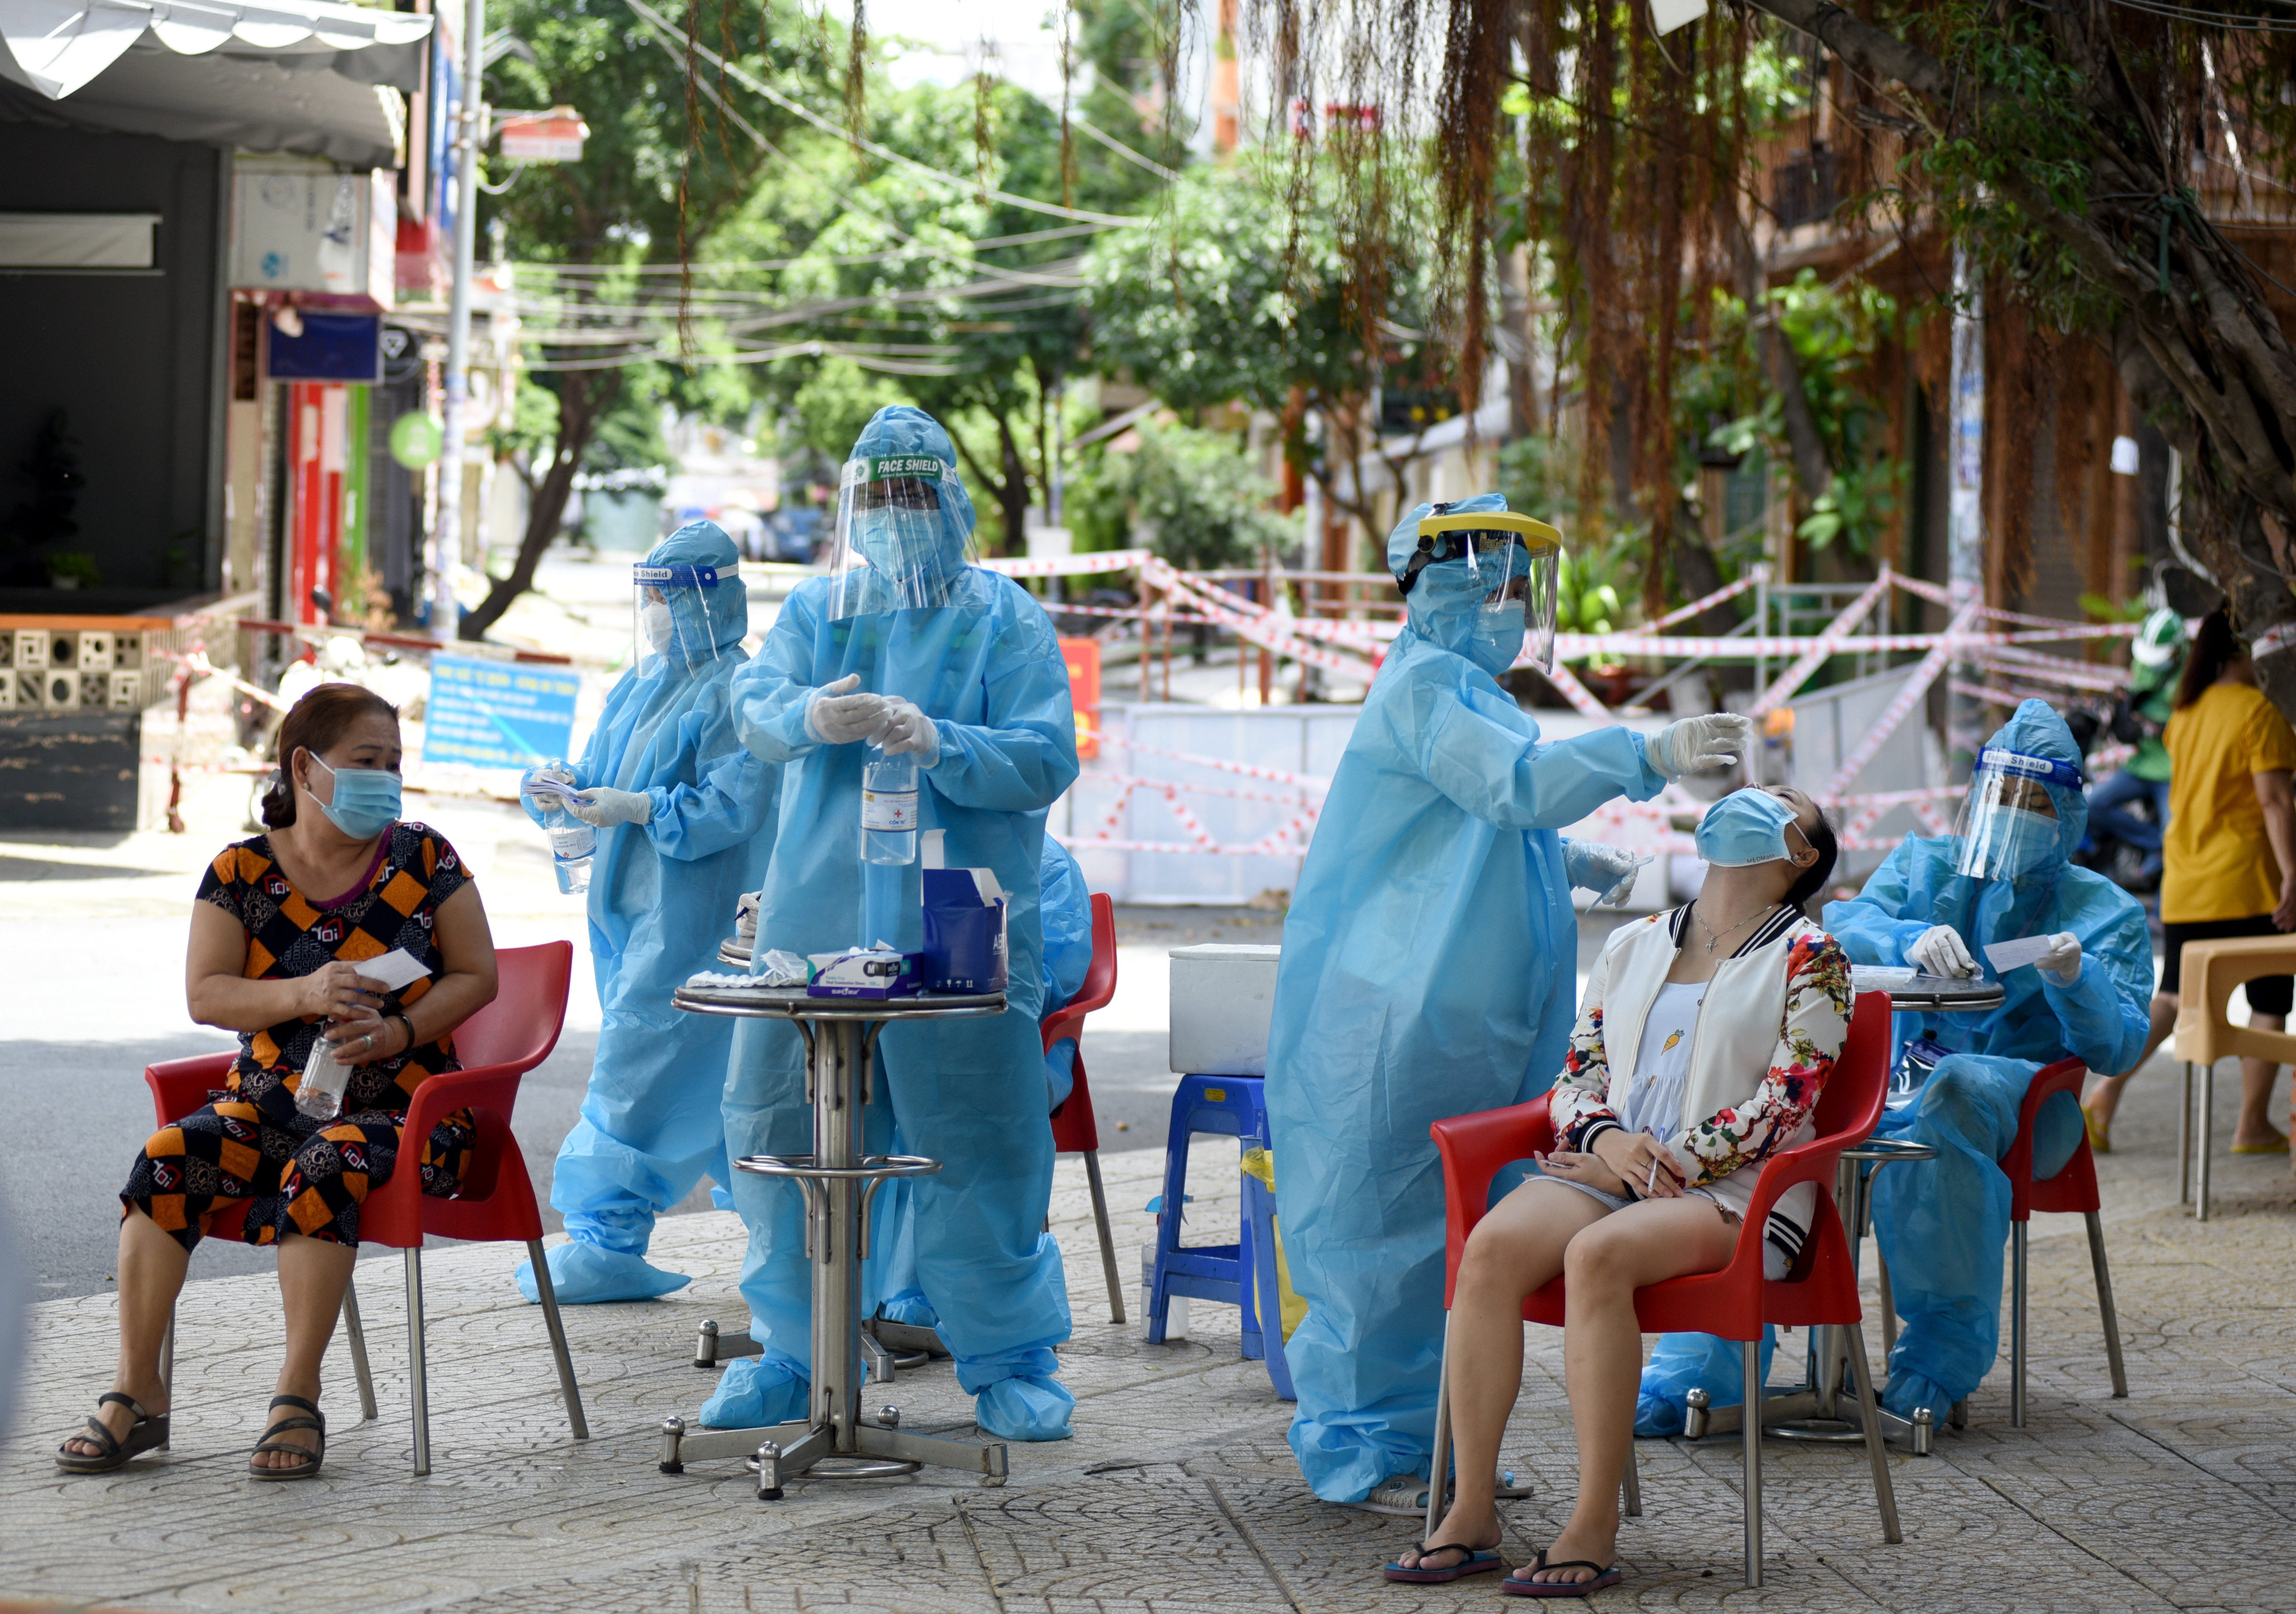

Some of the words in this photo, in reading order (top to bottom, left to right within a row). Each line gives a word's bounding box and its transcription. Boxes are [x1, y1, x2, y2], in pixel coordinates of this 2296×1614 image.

[877, 459, 904, 473] FACE
[905, 458, 938, 472] SHIELD
[2011, 756, 2047, 771] Shield
[1746, 853, 1776, 864] MEDMask
[867, 963, 876, 975] M
[339, 1141, 369, 1170] Dior
